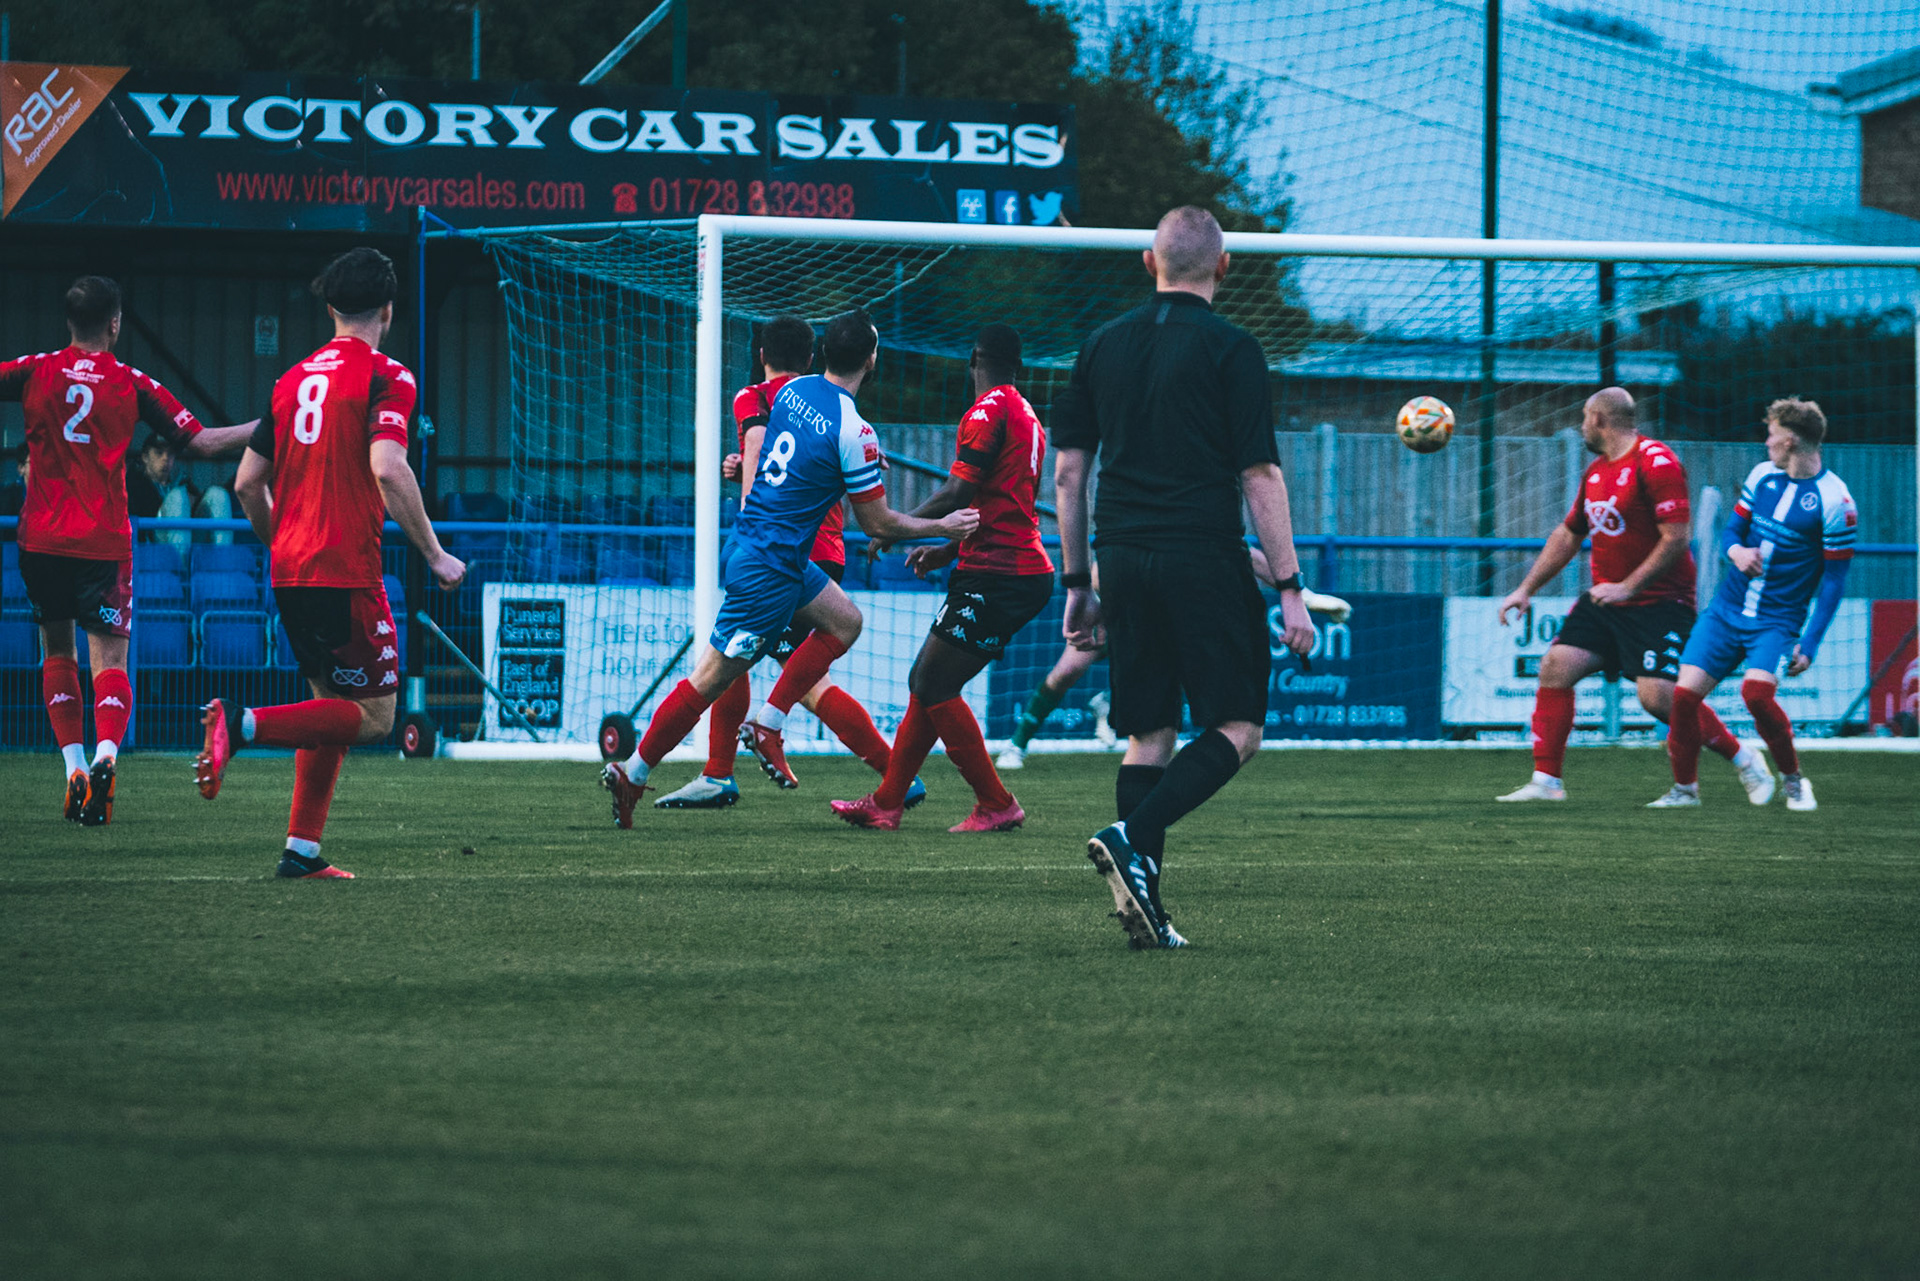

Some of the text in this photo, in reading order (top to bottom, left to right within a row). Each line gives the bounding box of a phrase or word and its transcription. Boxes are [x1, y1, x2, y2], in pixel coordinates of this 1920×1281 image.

[24, 97, 83, 168] Approved Dealer
[128, 92, 1066, 169] VICTORY CAR SALES
[216, 168, 856, 219] www.victorycarsales.com 01728 832938
[62, 383, 95, 445] 2
[293, 373, 330, 446] 8
[778, 387, 833, 436] FISHERS
[761, 430, 796, 488] 8
[502, 624, 562, 642] Services
[503, 605, 561, 624] Funeral
[603, 620, 658, 645] Here
[1277, 667, 1349, 700] Country
[1642, 649, 1658, 671] 6
[502, 677, 560, 697] England
